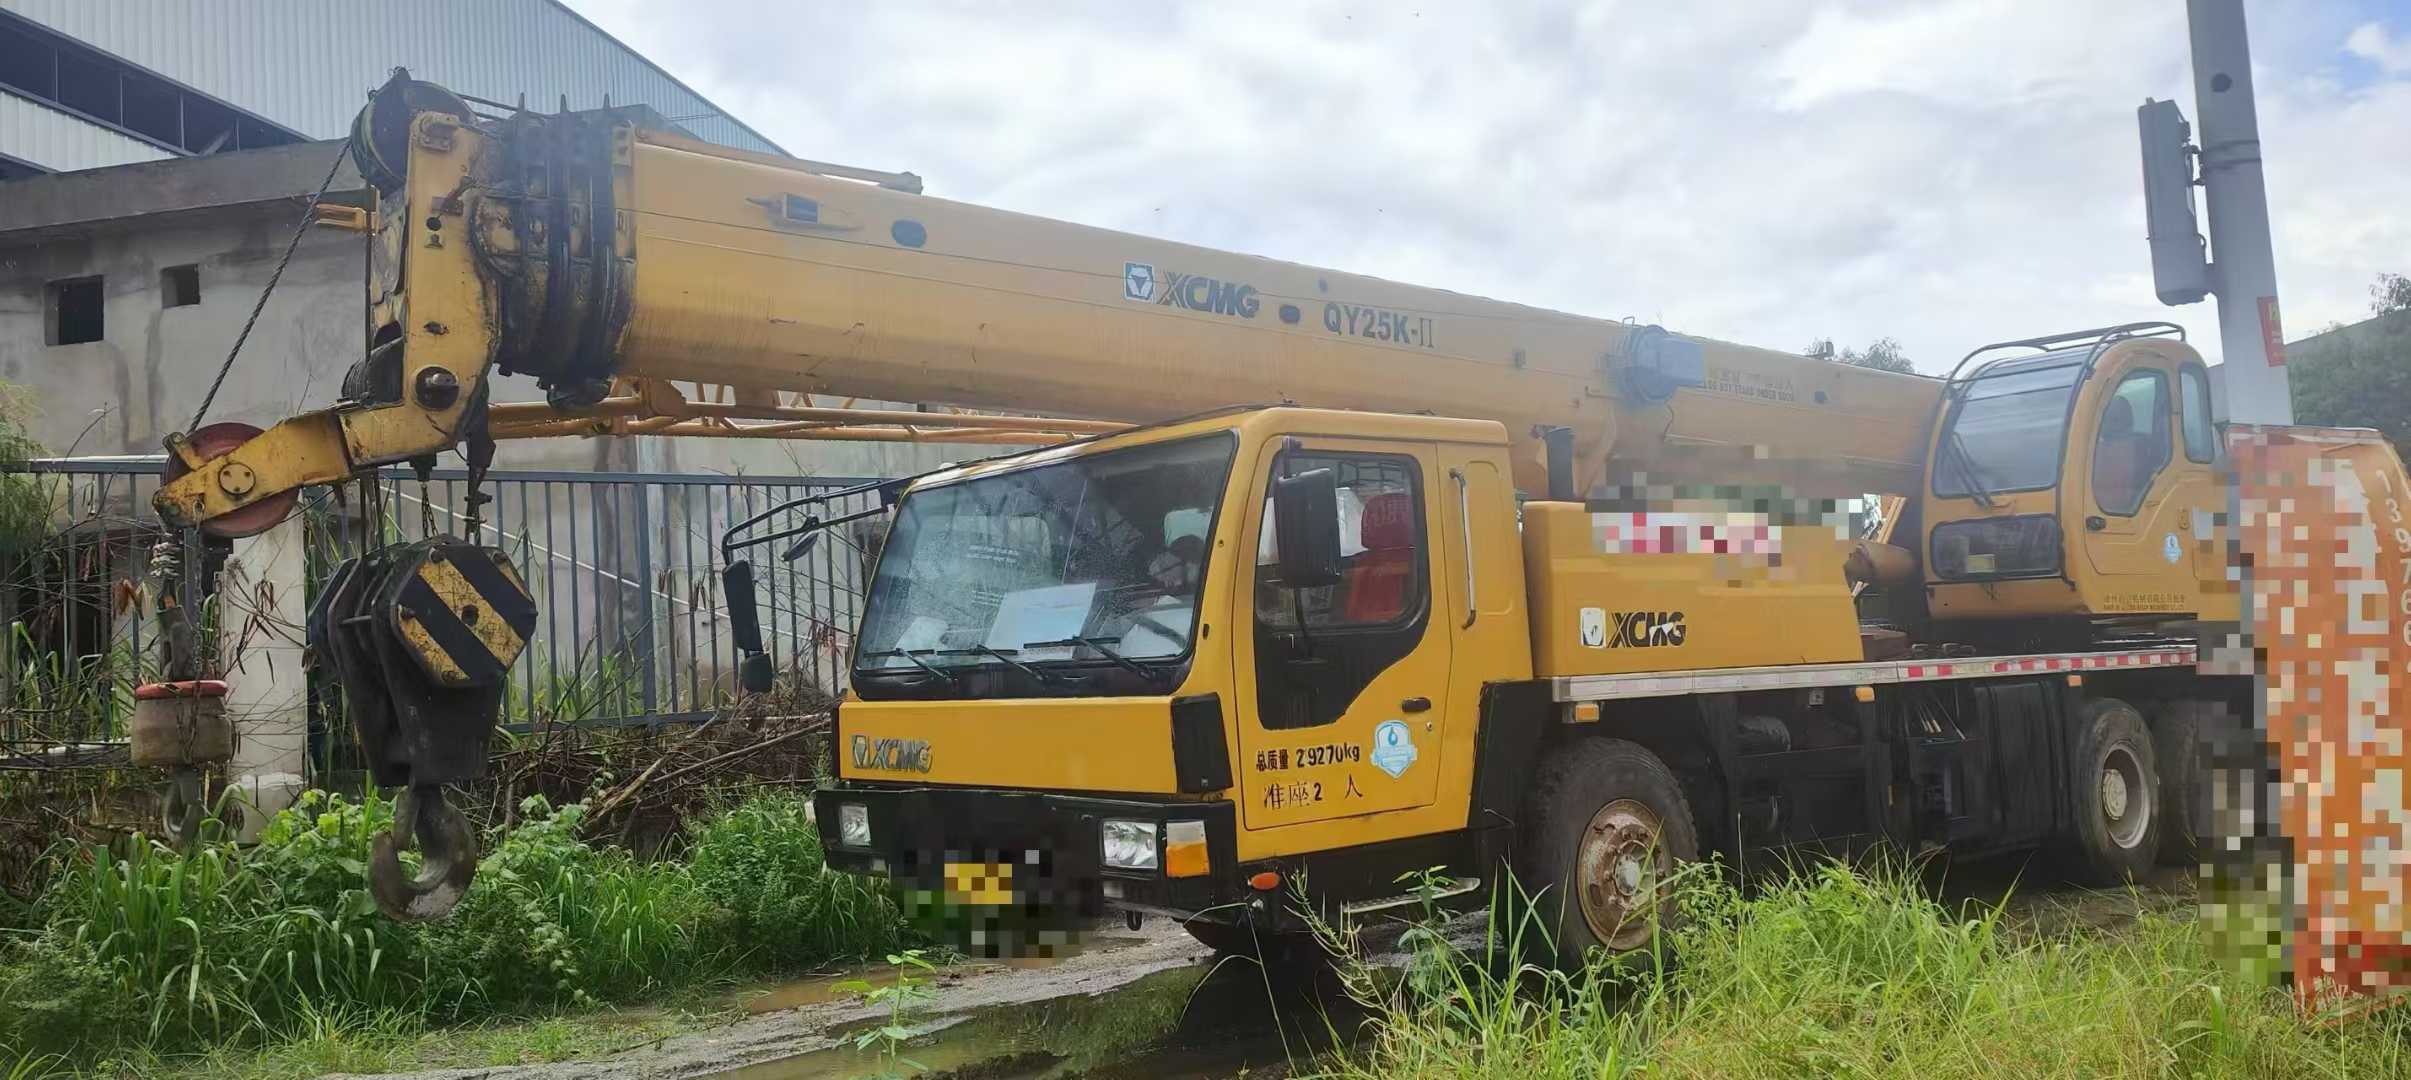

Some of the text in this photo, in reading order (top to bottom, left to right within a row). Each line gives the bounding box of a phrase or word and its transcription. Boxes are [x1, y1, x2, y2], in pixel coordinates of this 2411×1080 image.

[1158, 269, 1260, 318] XCMG
[869, 736, 934, 775] XCMG
[1256, 748, 1289, 772] 总质量
[1296, 742, 1360, 769] 29270kg
[1344, 773, 1364, 800] 人
